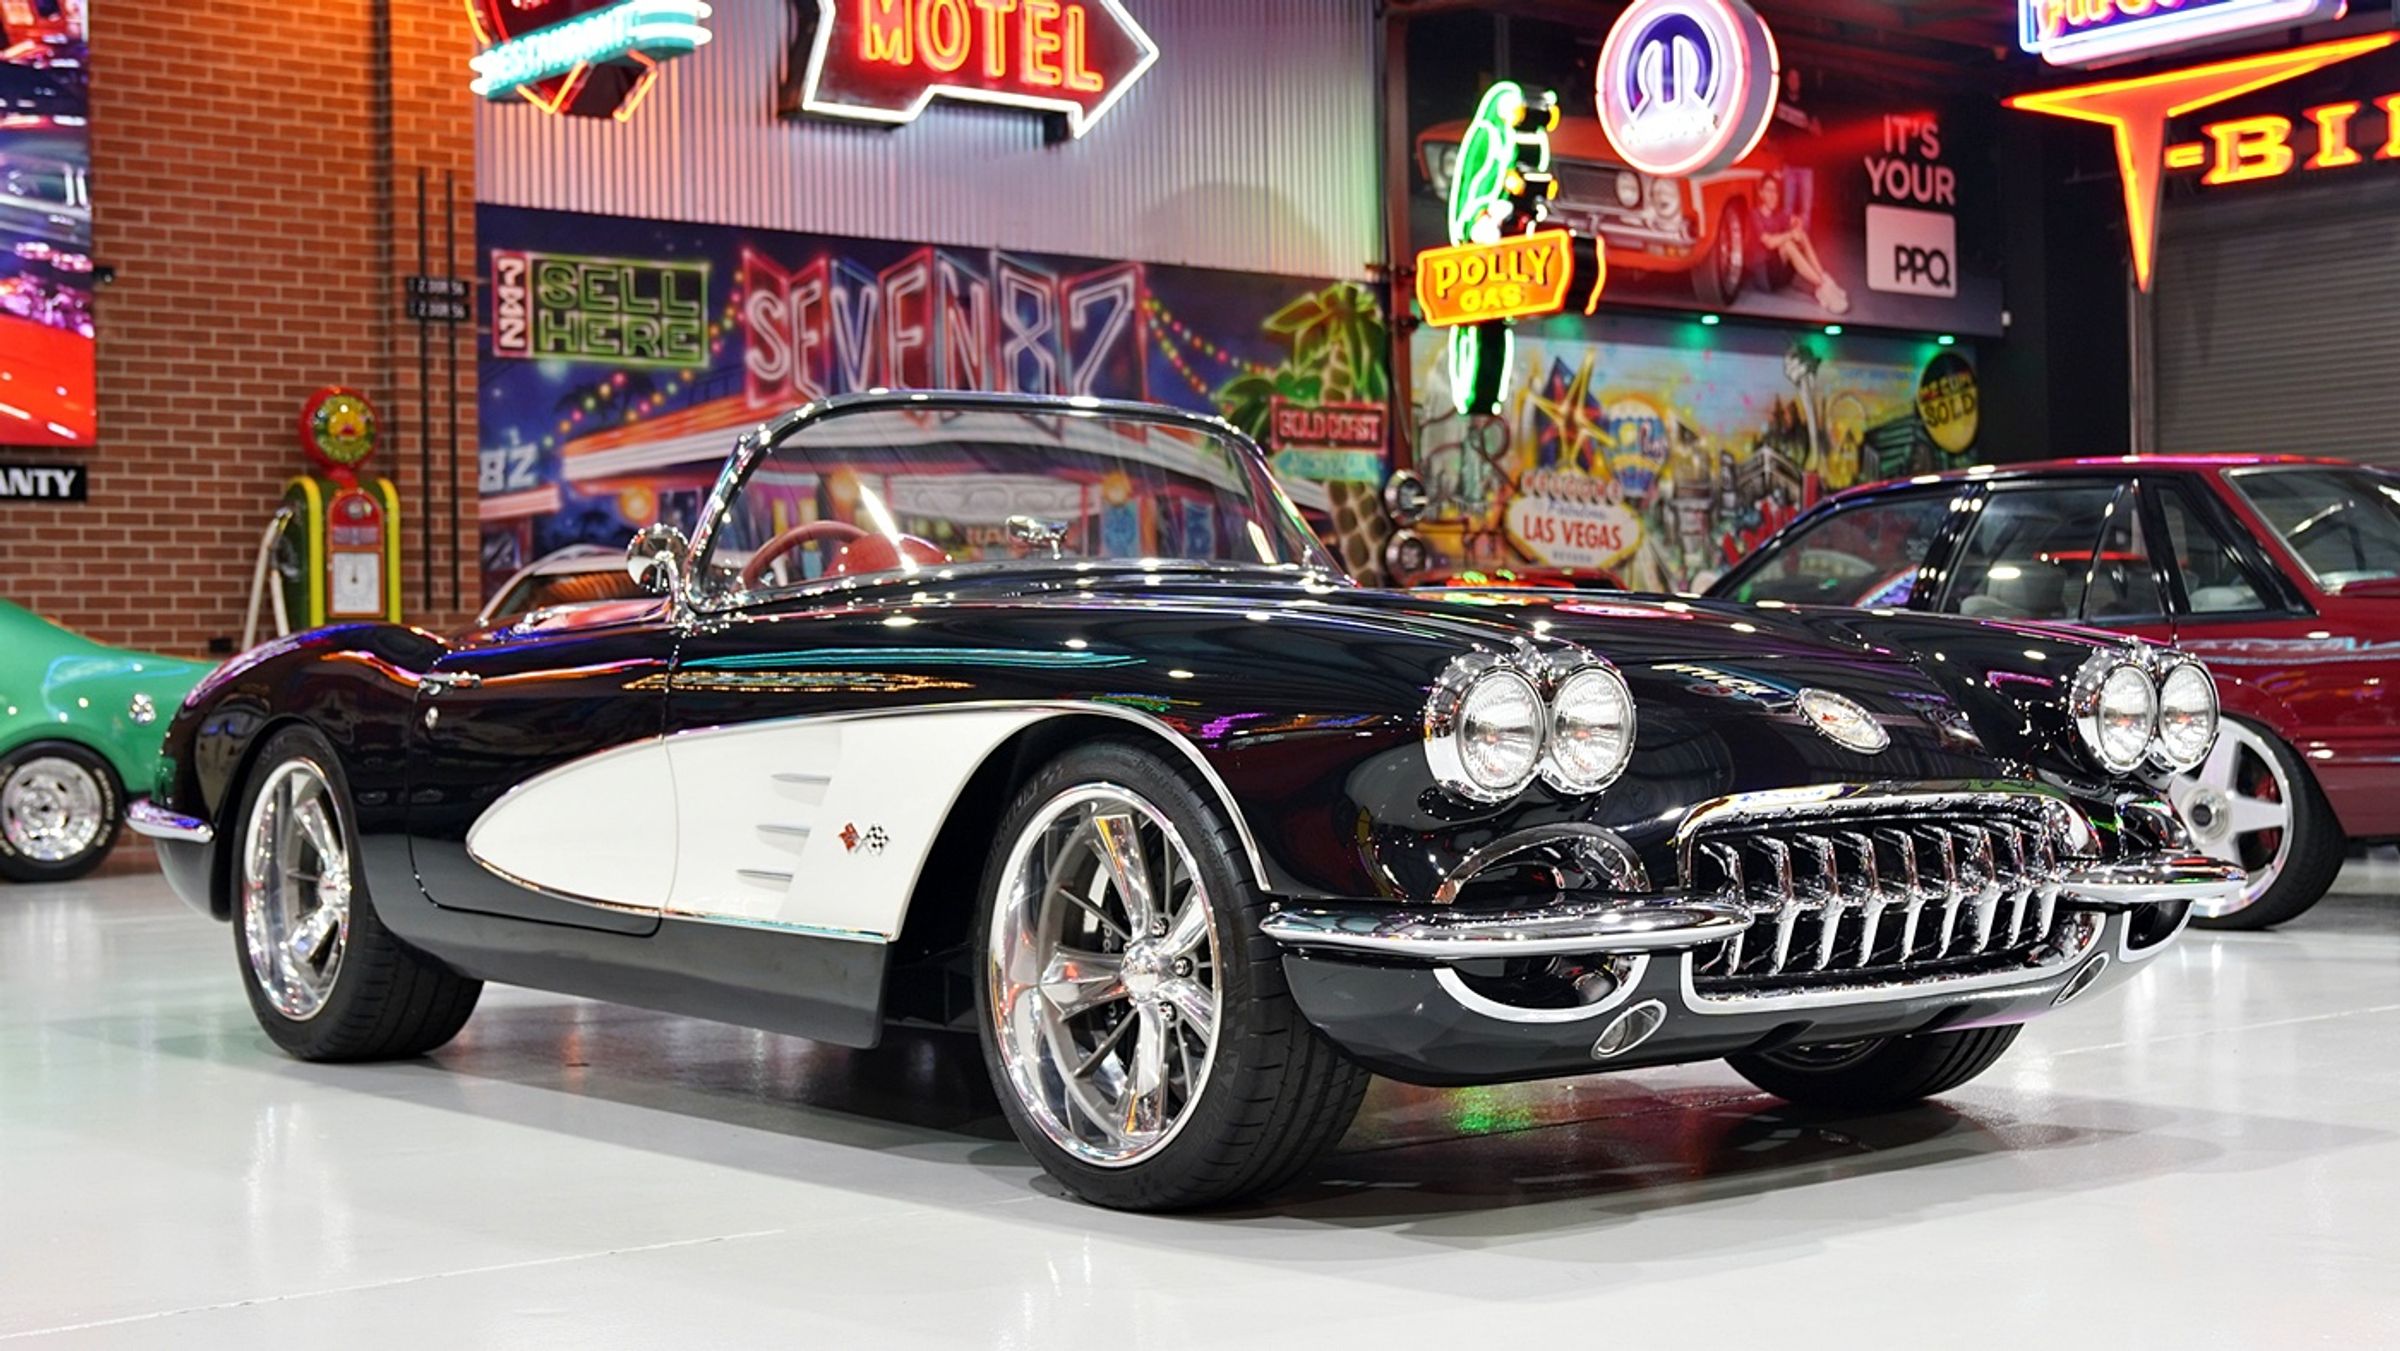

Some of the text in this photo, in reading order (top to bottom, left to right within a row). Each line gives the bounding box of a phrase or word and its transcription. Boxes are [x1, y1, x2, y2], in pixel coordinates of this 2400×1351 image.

[861, 0, 1104, 92] MOTEL
[1884, 114, 1940, 160] IT'S
[1864, 156, 1956, 206] YOUR
[539, 261, 701, 318] SELL
[1433, 246, 1553, 299] POLLY
[1894, 244, 1952, 288] PPQ
[1459, 283, 1523, 313] GAS
[539, 308, 702, 360] HERE
[1924, 393, 1975, 427] SOLD
[1523, 514, 1623, 551] LAS VEGAS
